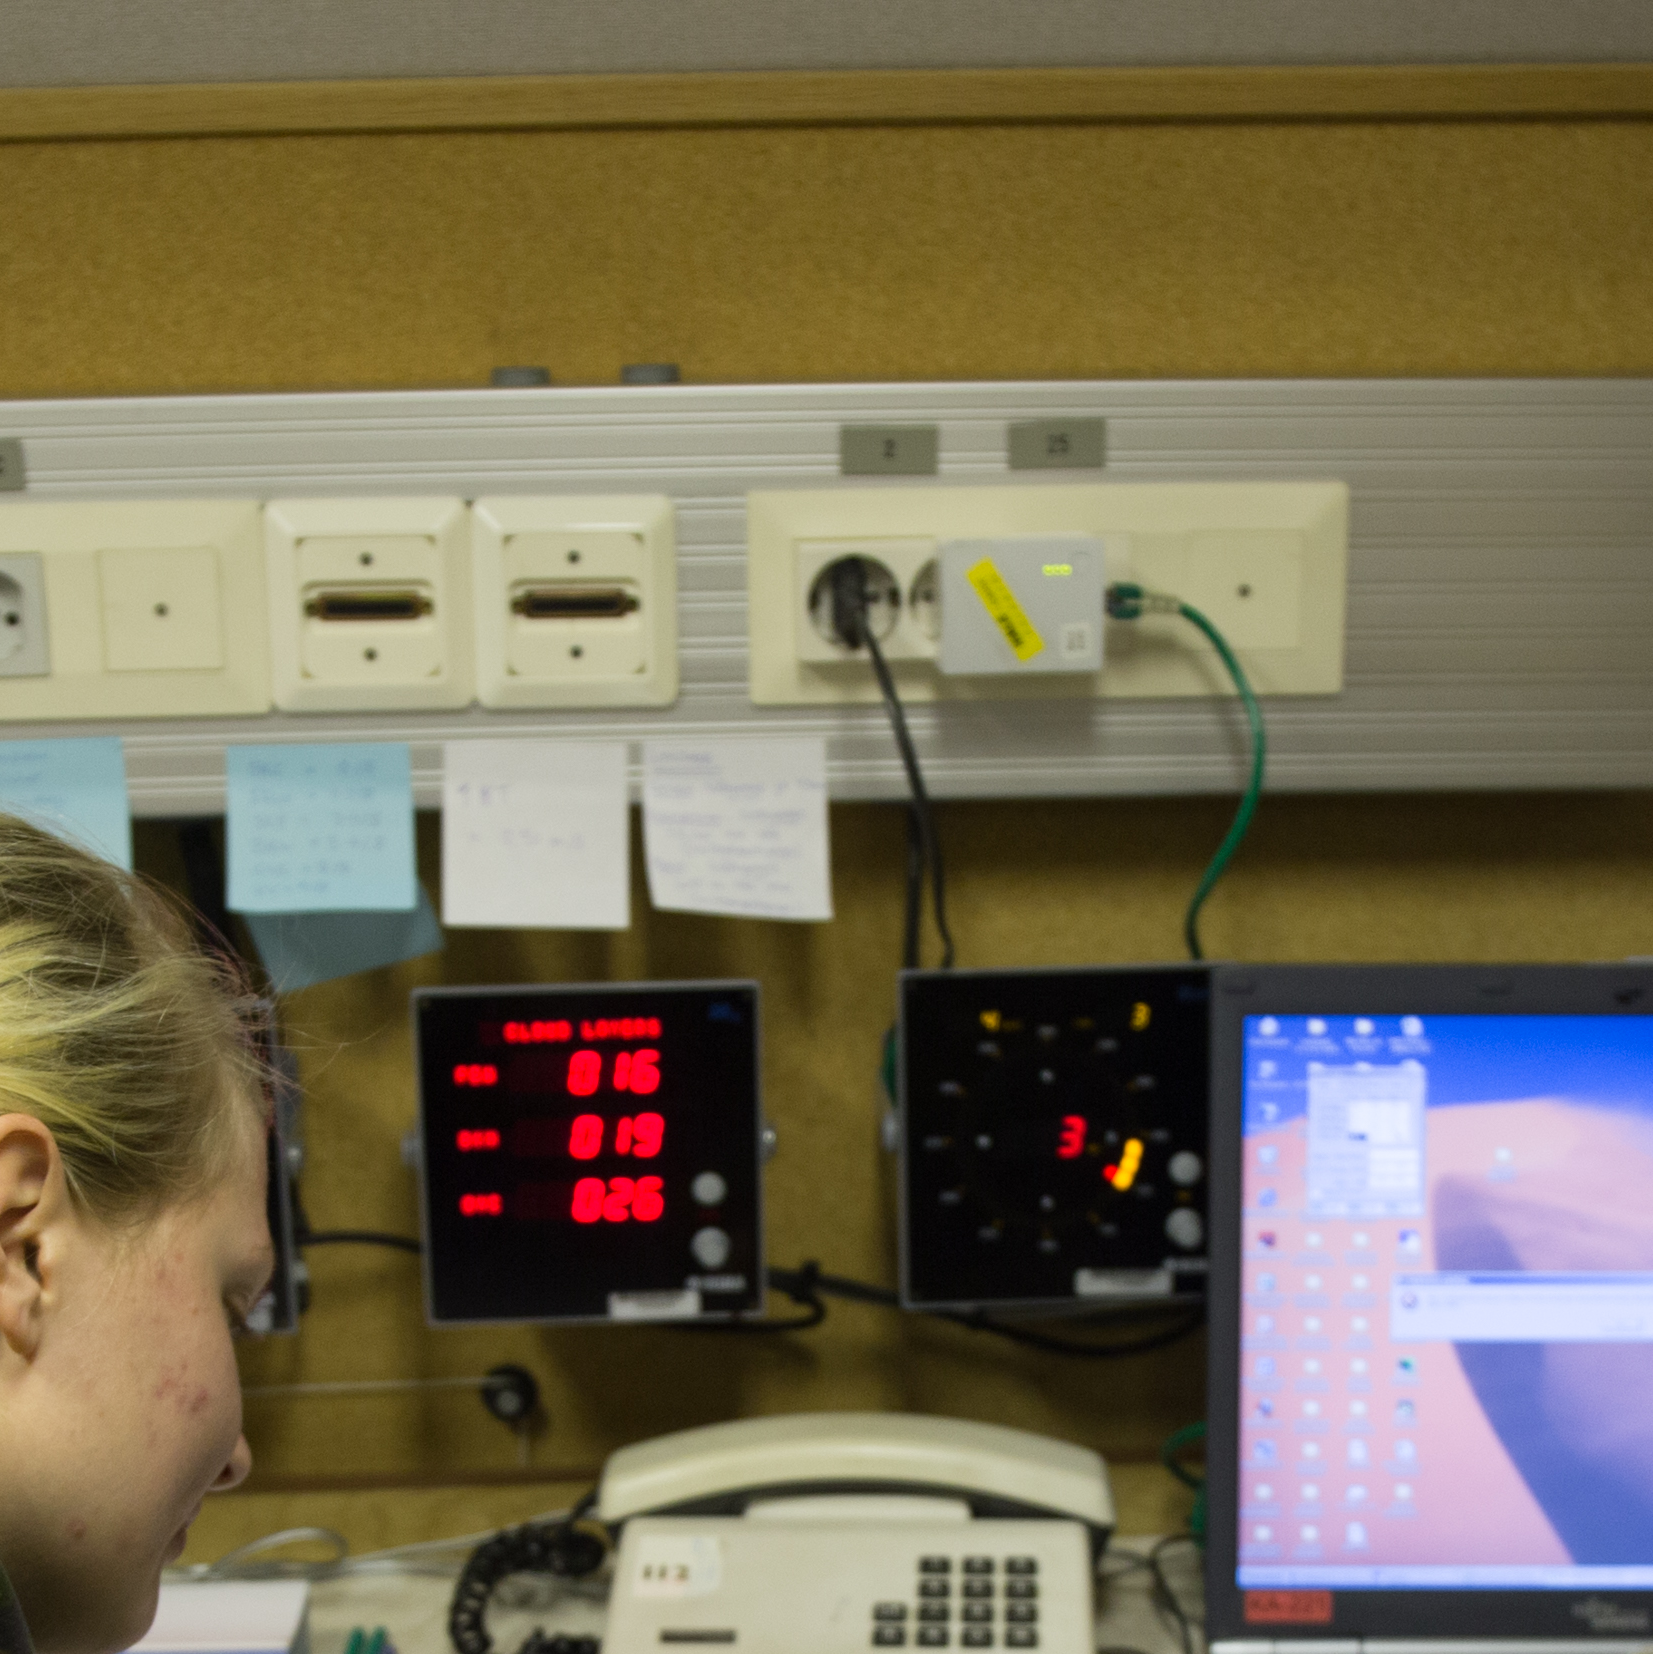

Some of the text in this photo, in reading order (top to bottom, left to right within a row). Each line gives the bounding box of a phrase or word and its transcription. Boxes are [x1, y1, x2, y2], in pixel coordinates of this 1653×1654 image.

[567, 1048, 660, 1096] 016
[568, 1112, 665, 1160] 019
[1057, 1115, 1087, 1158] 3
[571, 1176, 664, 1224] 026
